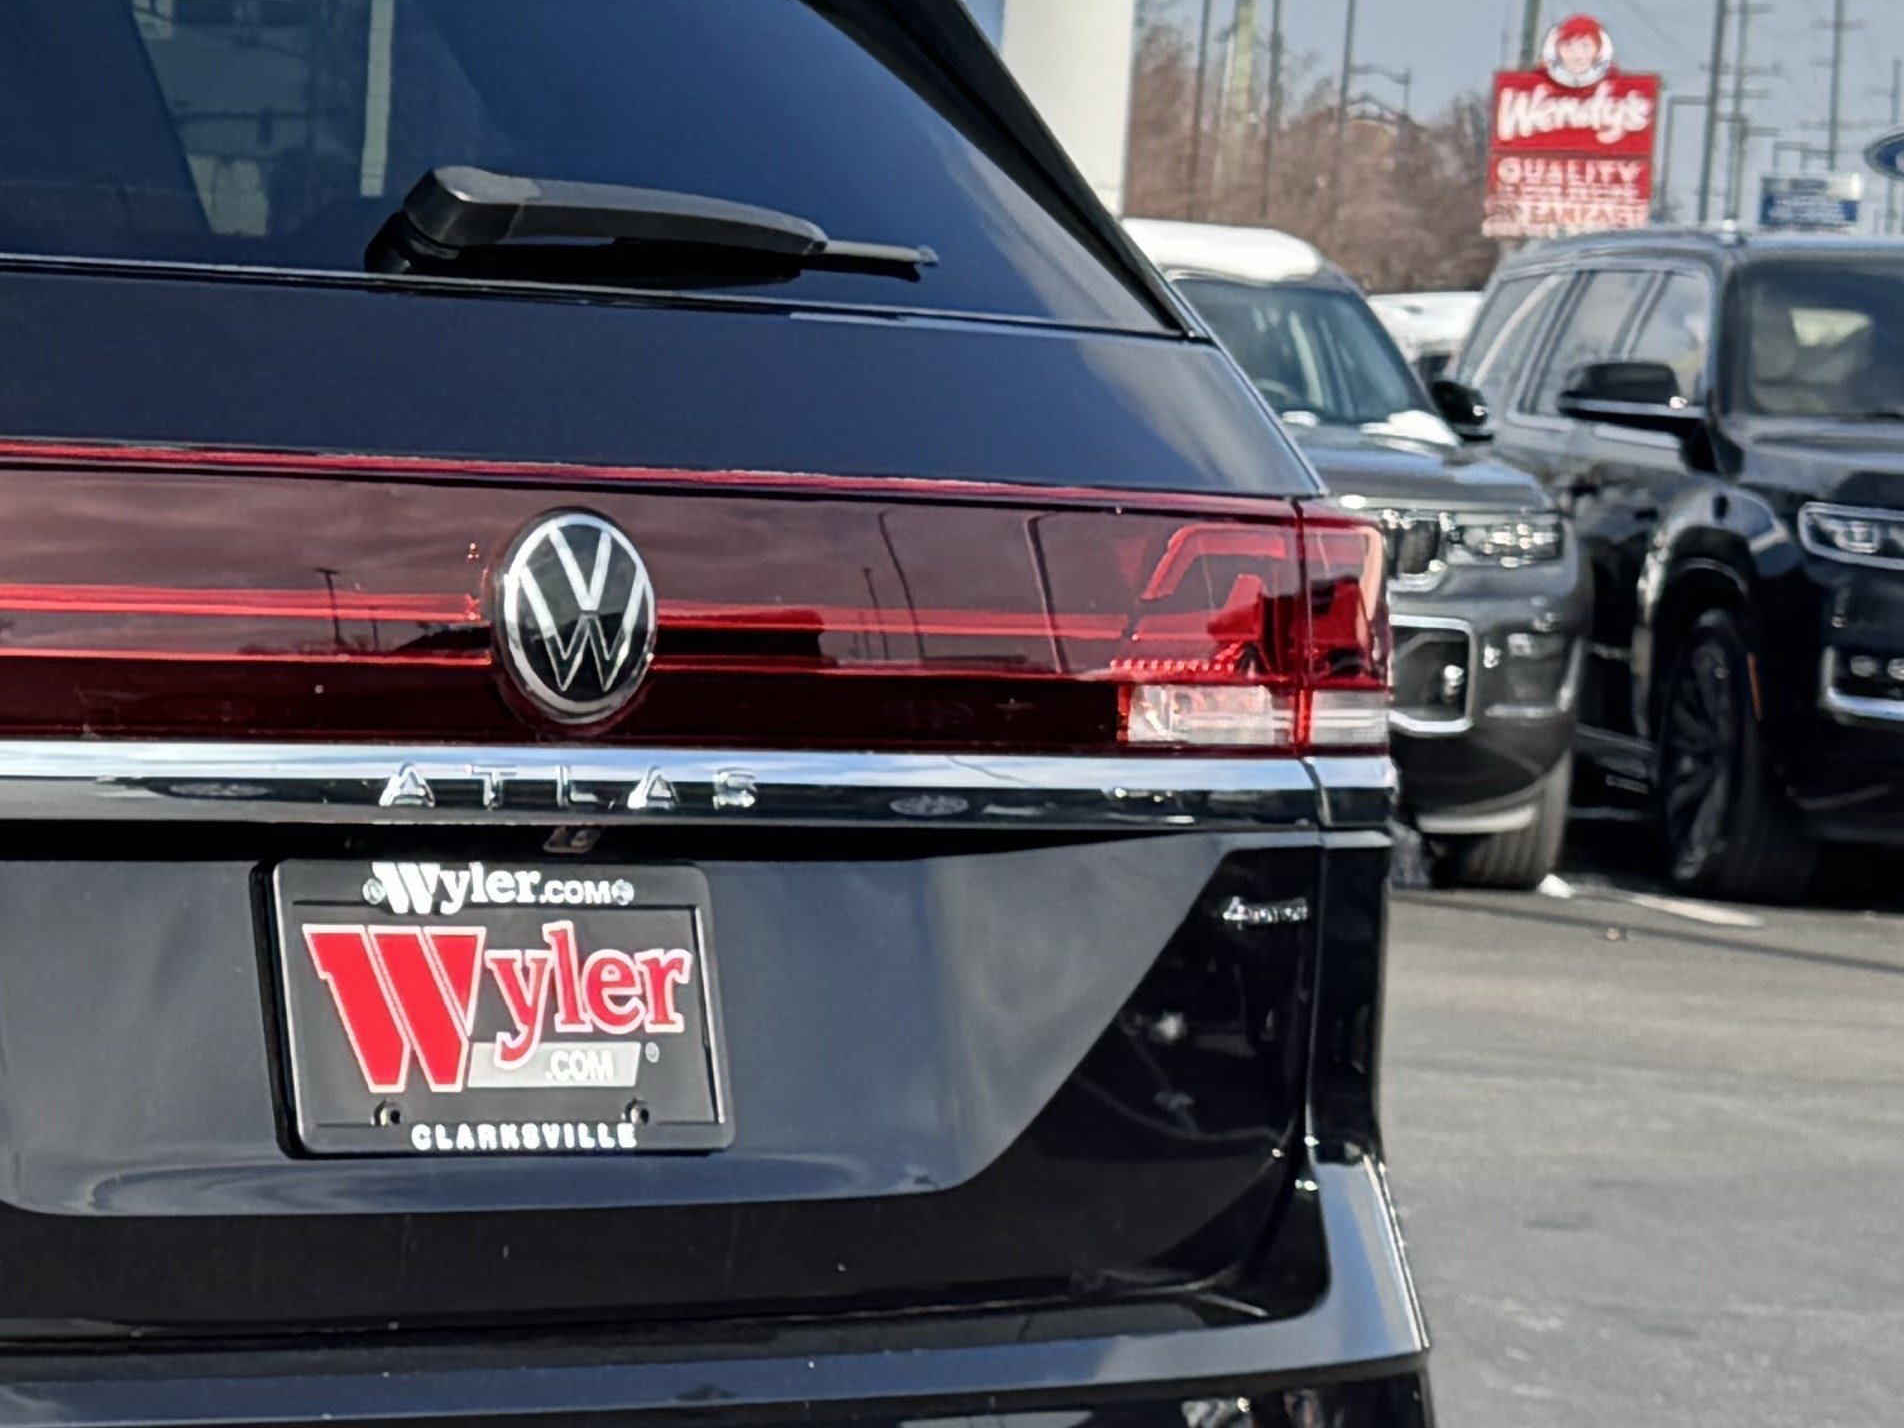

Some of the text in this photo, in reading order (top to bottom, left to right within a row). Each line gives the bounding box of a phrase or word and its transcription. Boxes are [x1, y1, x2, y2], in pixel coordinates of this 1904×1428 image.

[1497, 81, 1653, 143] Wendy's
[1497, 156, 1642, 186] QUALITY
[379, 762, 759, 811] ATLAS
[302, 919, 693, 1094] Wyler
[410, 1122, 639, 1152] CLARKSVILLE
